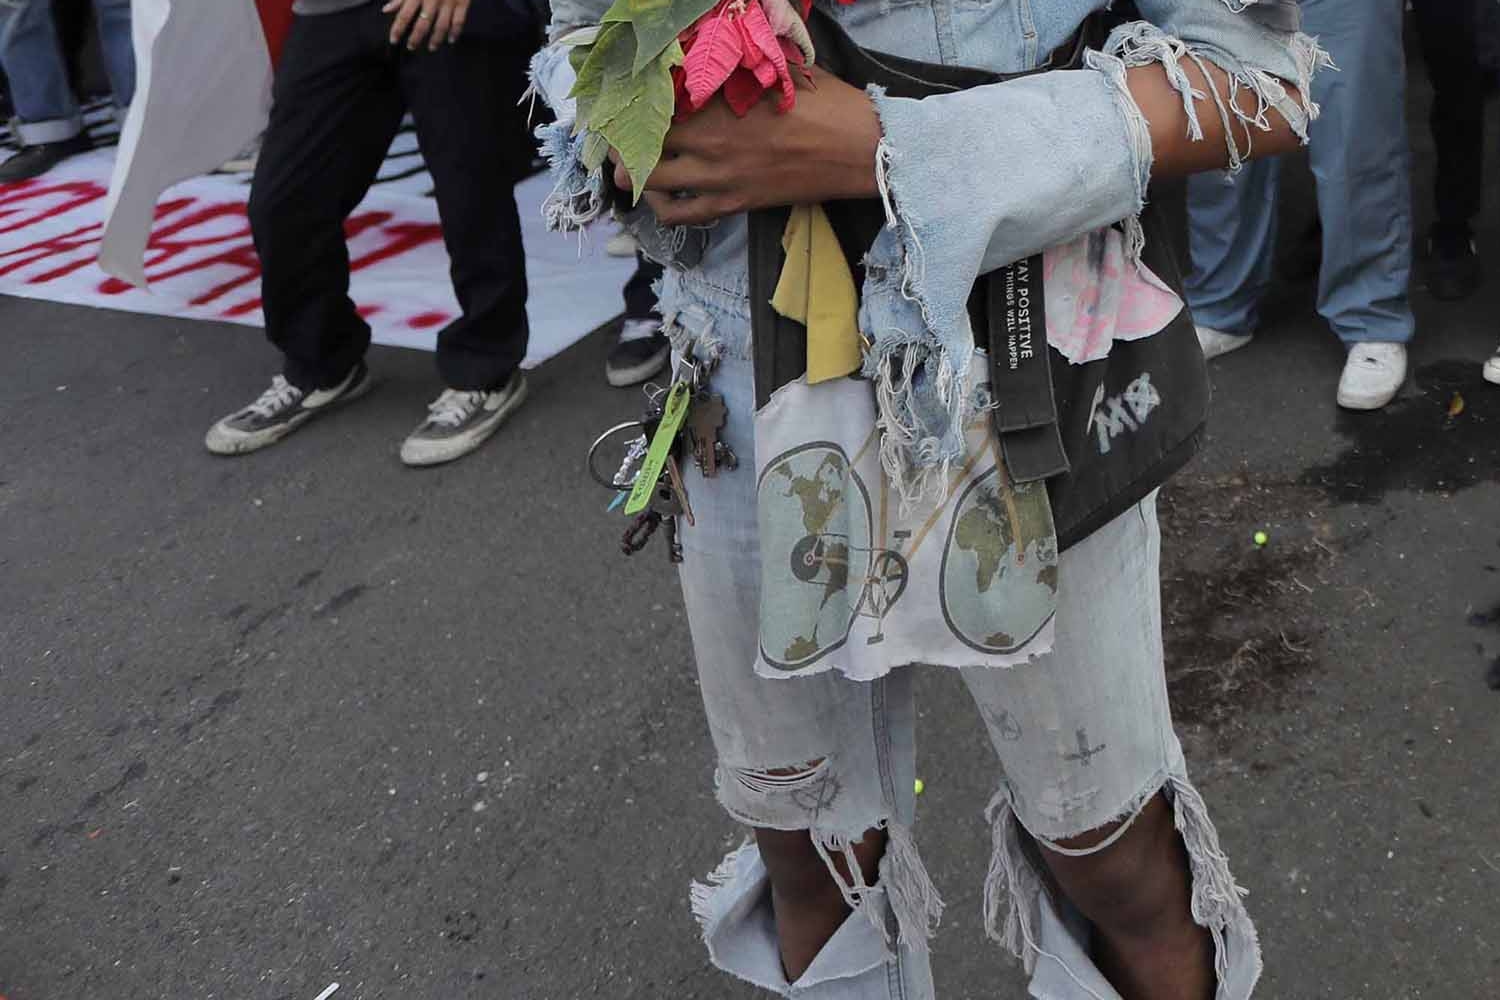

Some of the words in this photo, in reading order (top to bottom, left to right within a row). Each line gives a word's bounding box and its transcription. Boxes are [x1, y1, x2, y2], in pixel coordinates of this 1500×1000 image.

[1018, 258, 1029, 282] TAY
[1006, 271, 1015, 306] THINGS
[1007, 309, 1016, 332] WILL
[1018, 288, 1033, 359] POSITIVE
[1008, 335, 1018, 369] HAPPEN
